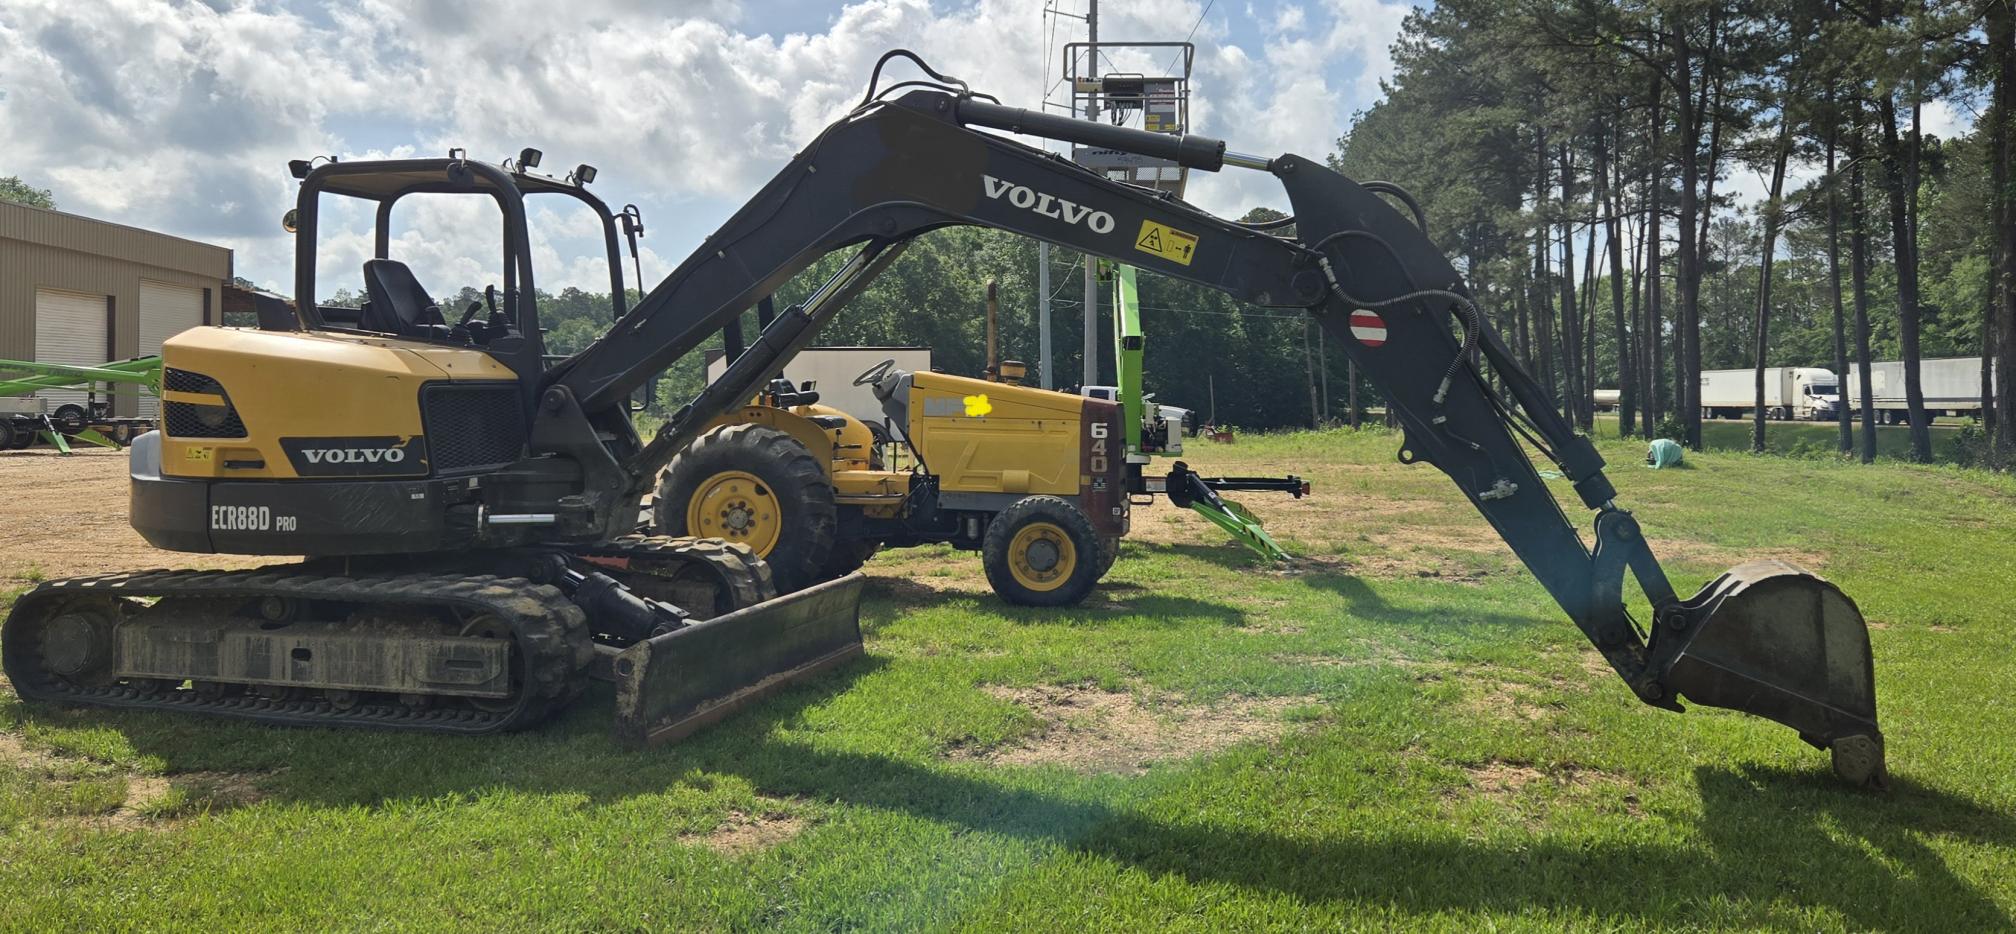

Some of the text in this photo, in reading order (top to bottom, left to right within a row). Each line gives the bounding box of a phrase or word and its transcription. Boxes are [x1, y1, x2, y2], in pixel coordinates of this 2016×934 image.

[983, 174, 1115, 234] VOLVO
[302, 448, 404, 463] VOLVO
[1090, 422, 1108, 473] 640
[211, 505, 297, 532] ECR88D PRO
